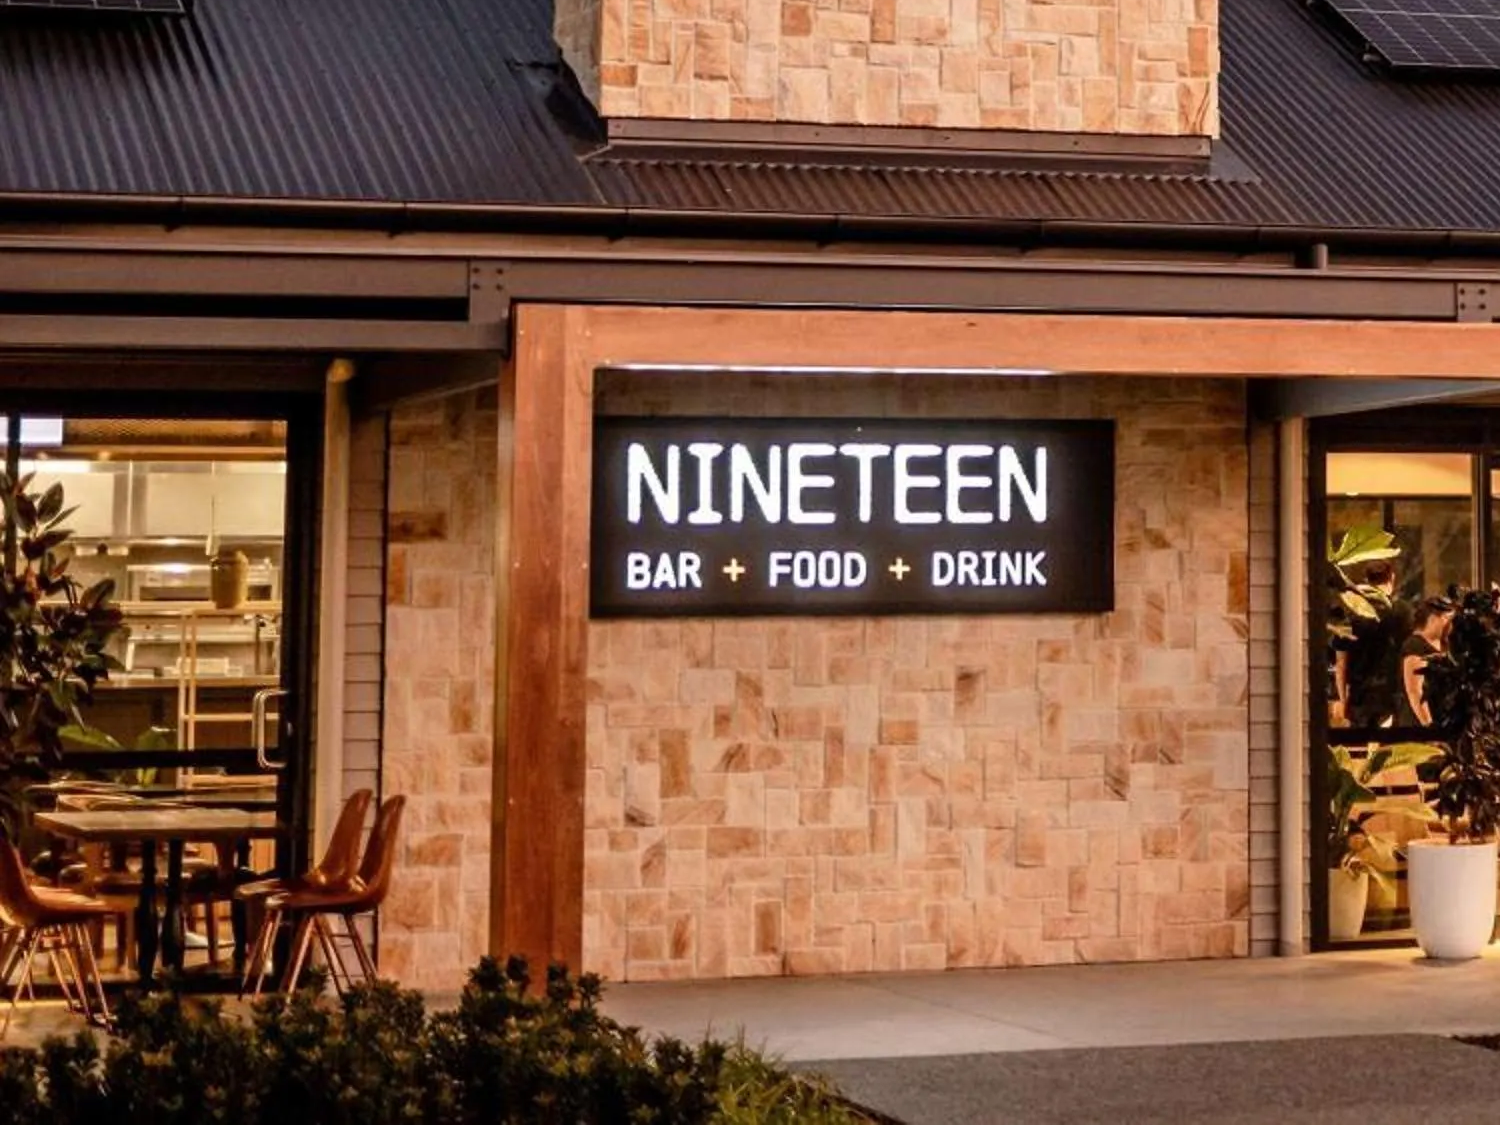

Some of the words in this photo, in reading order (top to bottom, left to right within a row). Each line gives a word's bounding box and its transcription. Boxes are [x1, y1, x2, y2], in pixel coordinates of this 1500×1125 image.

[626, 441, 1049, 526] NINETEEN
[625, 551, 703, 590] BAR
[722, 557, 746, 582] +
[767, 550, 868, 589] FOOD
[888, 557, 911, 581] +
[931, 550, 1048, 587] DRINK
